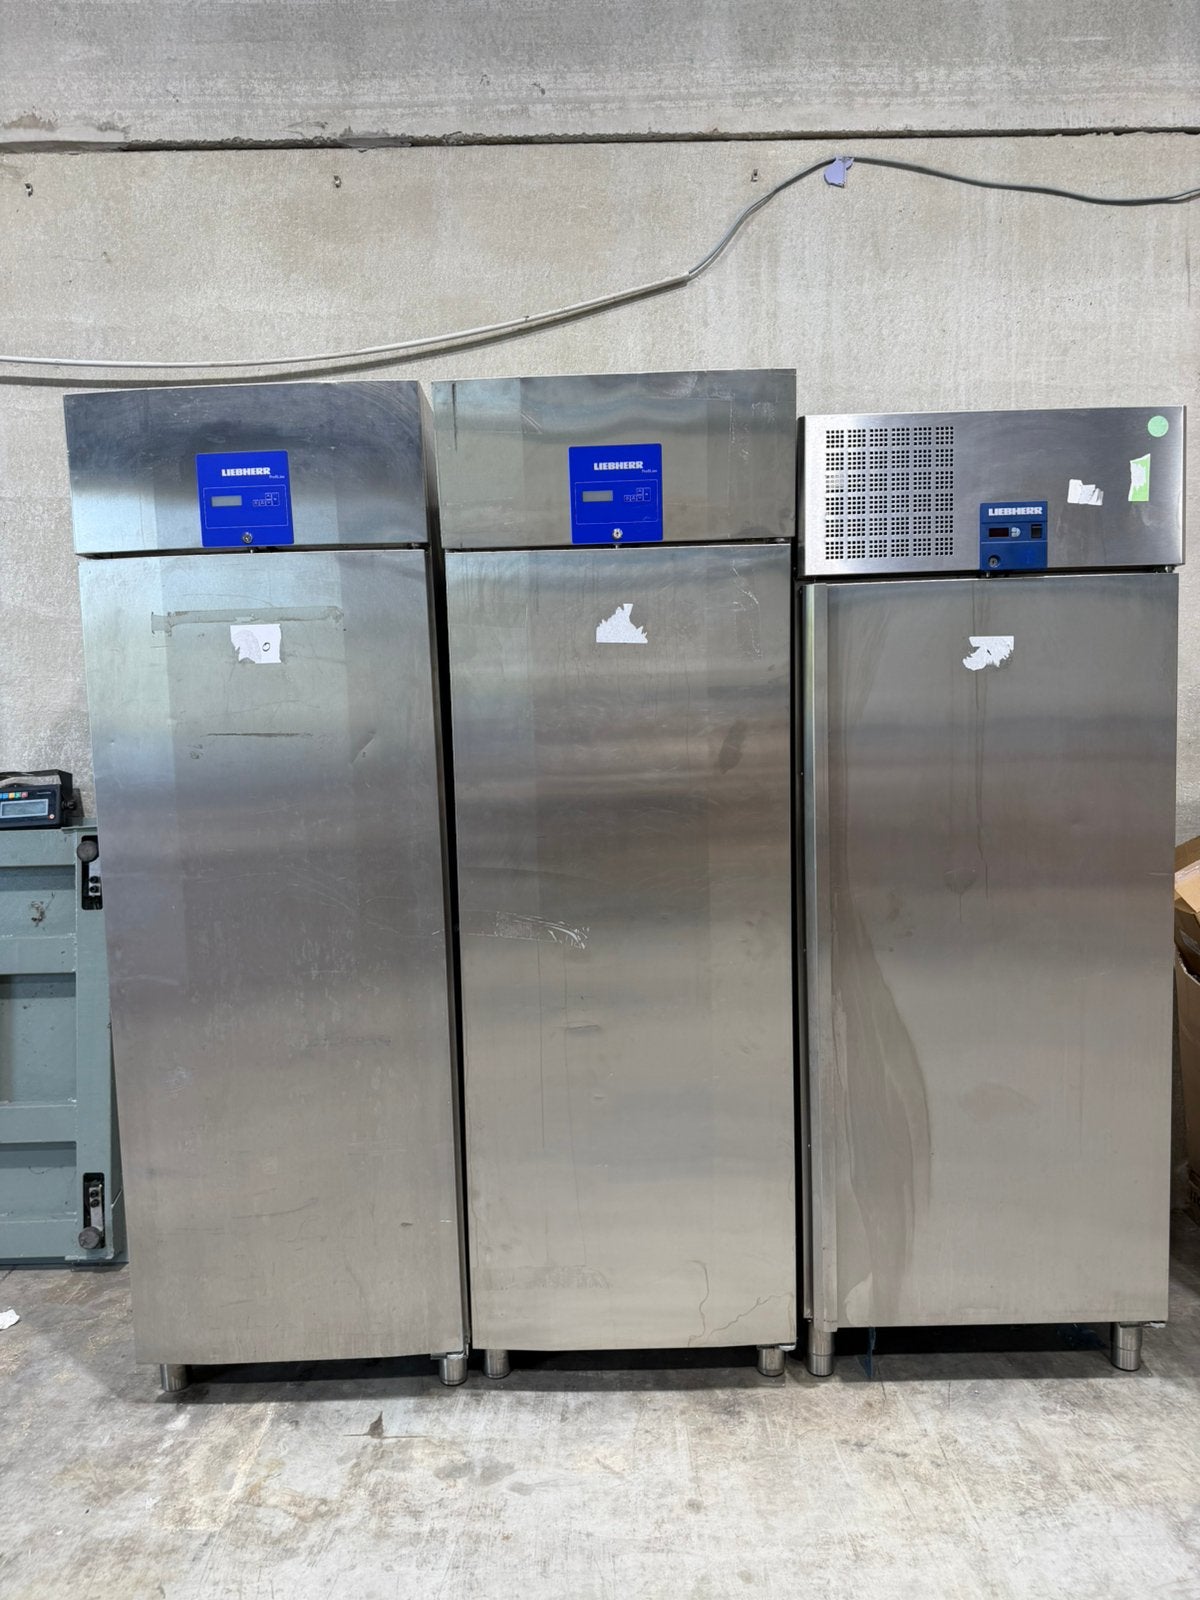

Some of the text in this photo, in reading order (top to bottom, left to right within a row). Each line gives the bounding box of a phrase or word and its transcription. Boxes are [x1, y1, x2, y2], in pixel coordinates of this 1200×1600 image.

[593, 460, 644, 471] LIEBHERR
[221, 467, 271, 477] LIEBHERR
[988, 506, 1043, 516] LIEBHERR
